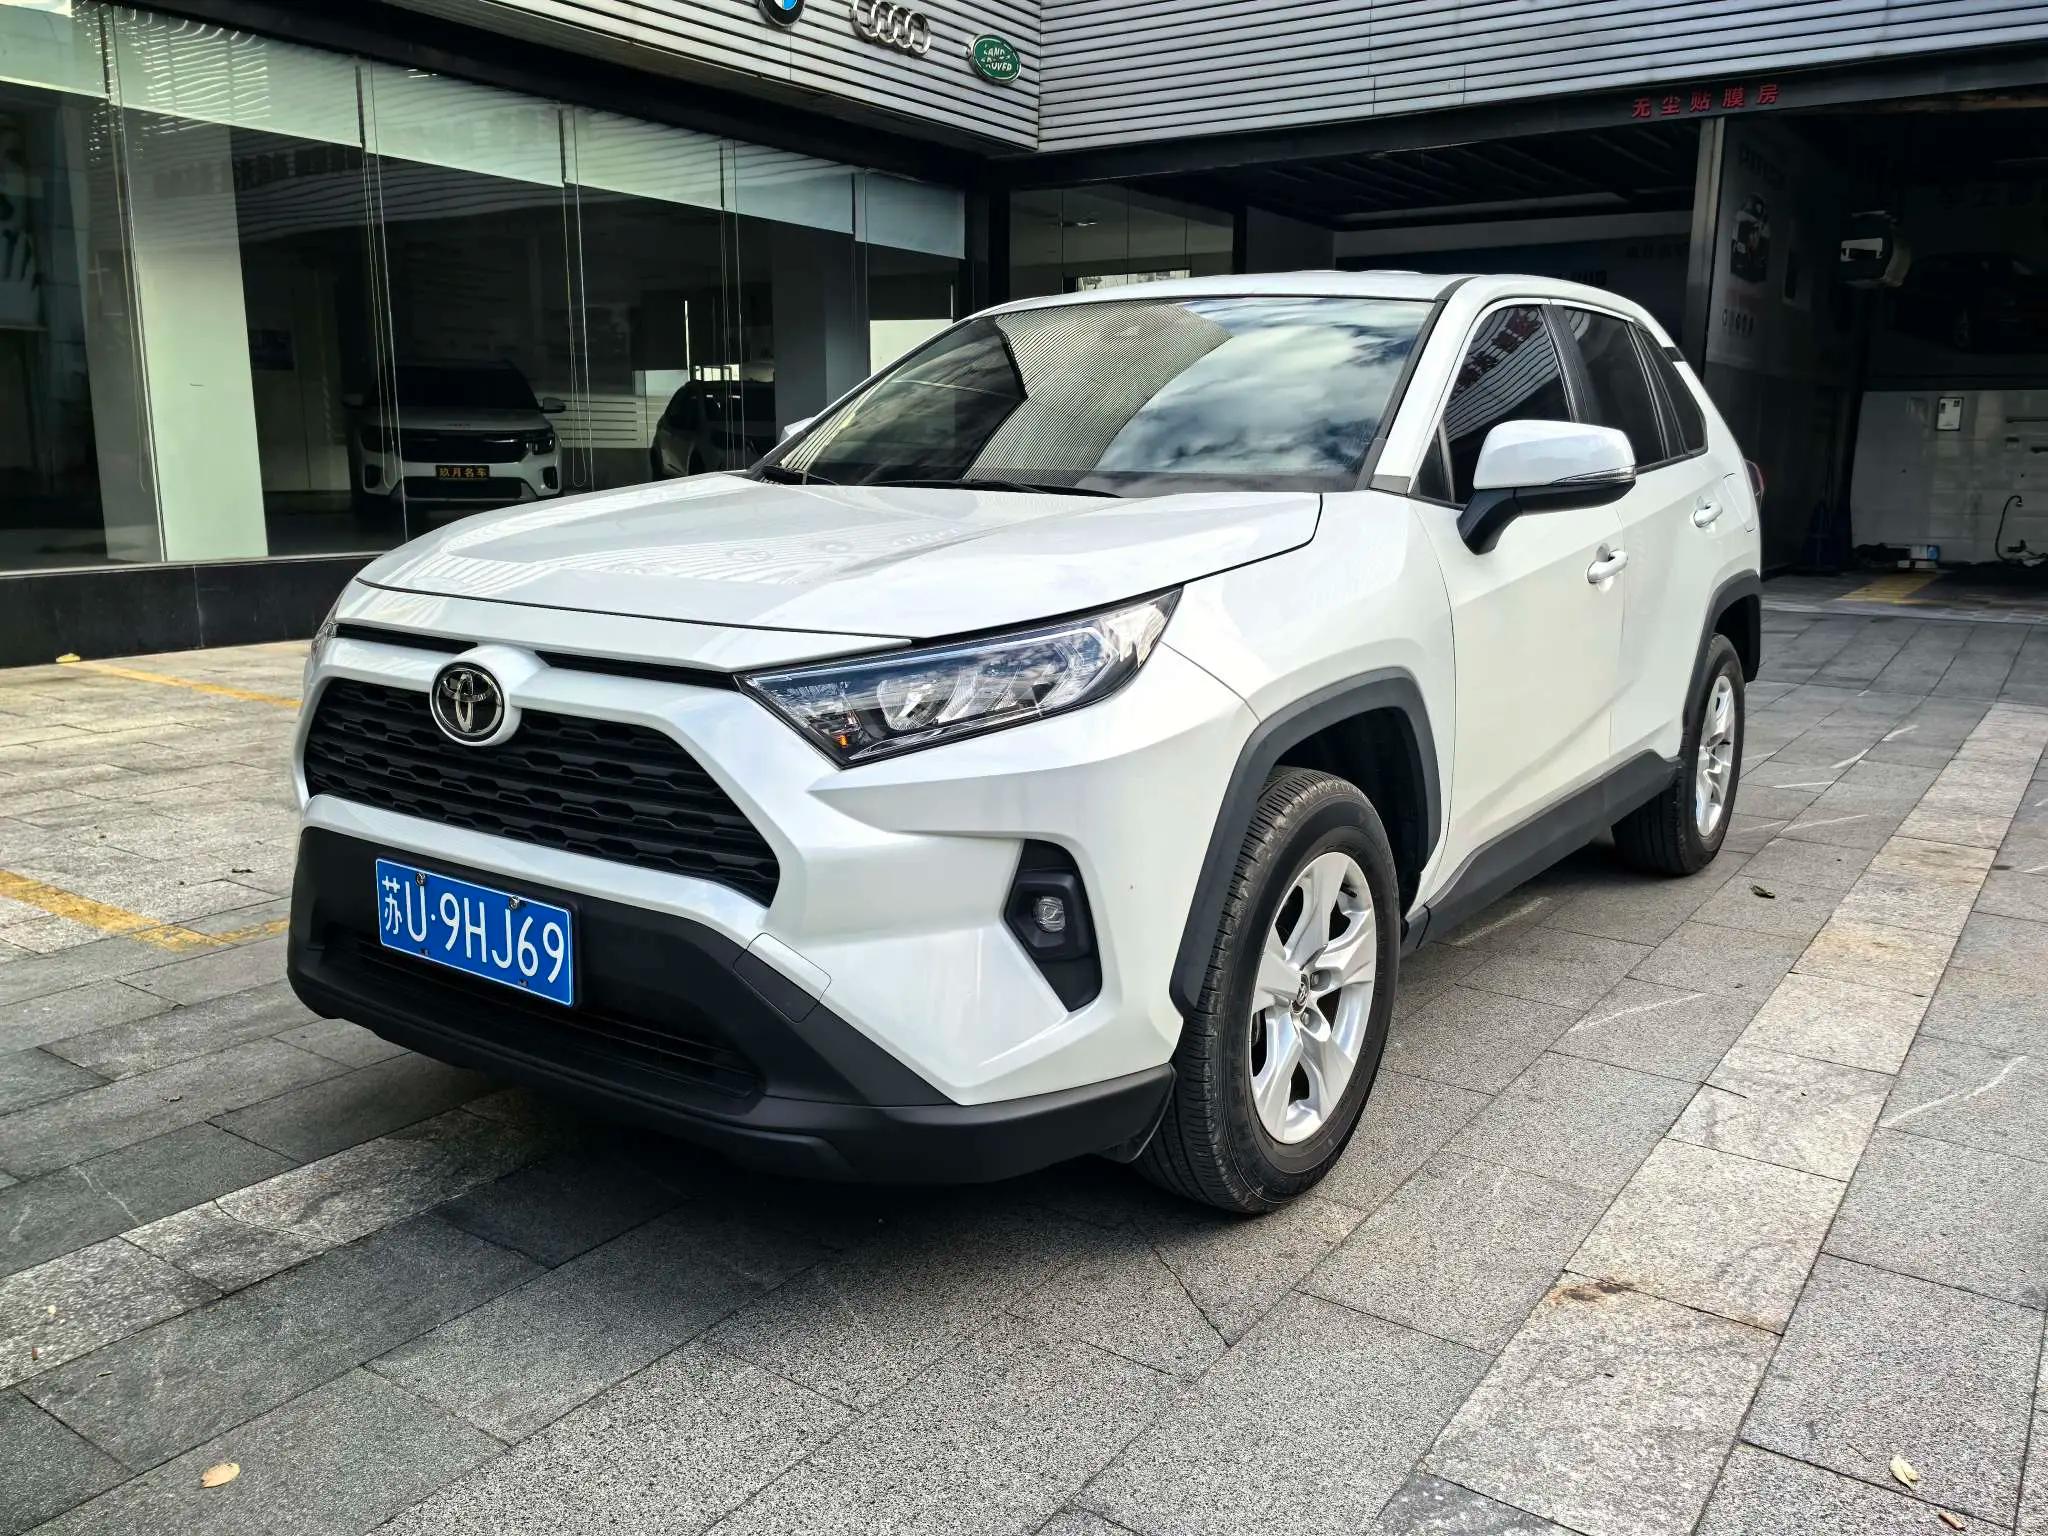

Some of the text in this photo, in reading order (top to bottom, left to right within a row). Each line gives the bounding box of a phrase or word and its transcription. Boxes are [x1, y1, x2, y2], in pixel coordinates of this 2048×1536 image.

[1631, 84, 1778, 118] 无尘贴膜房
